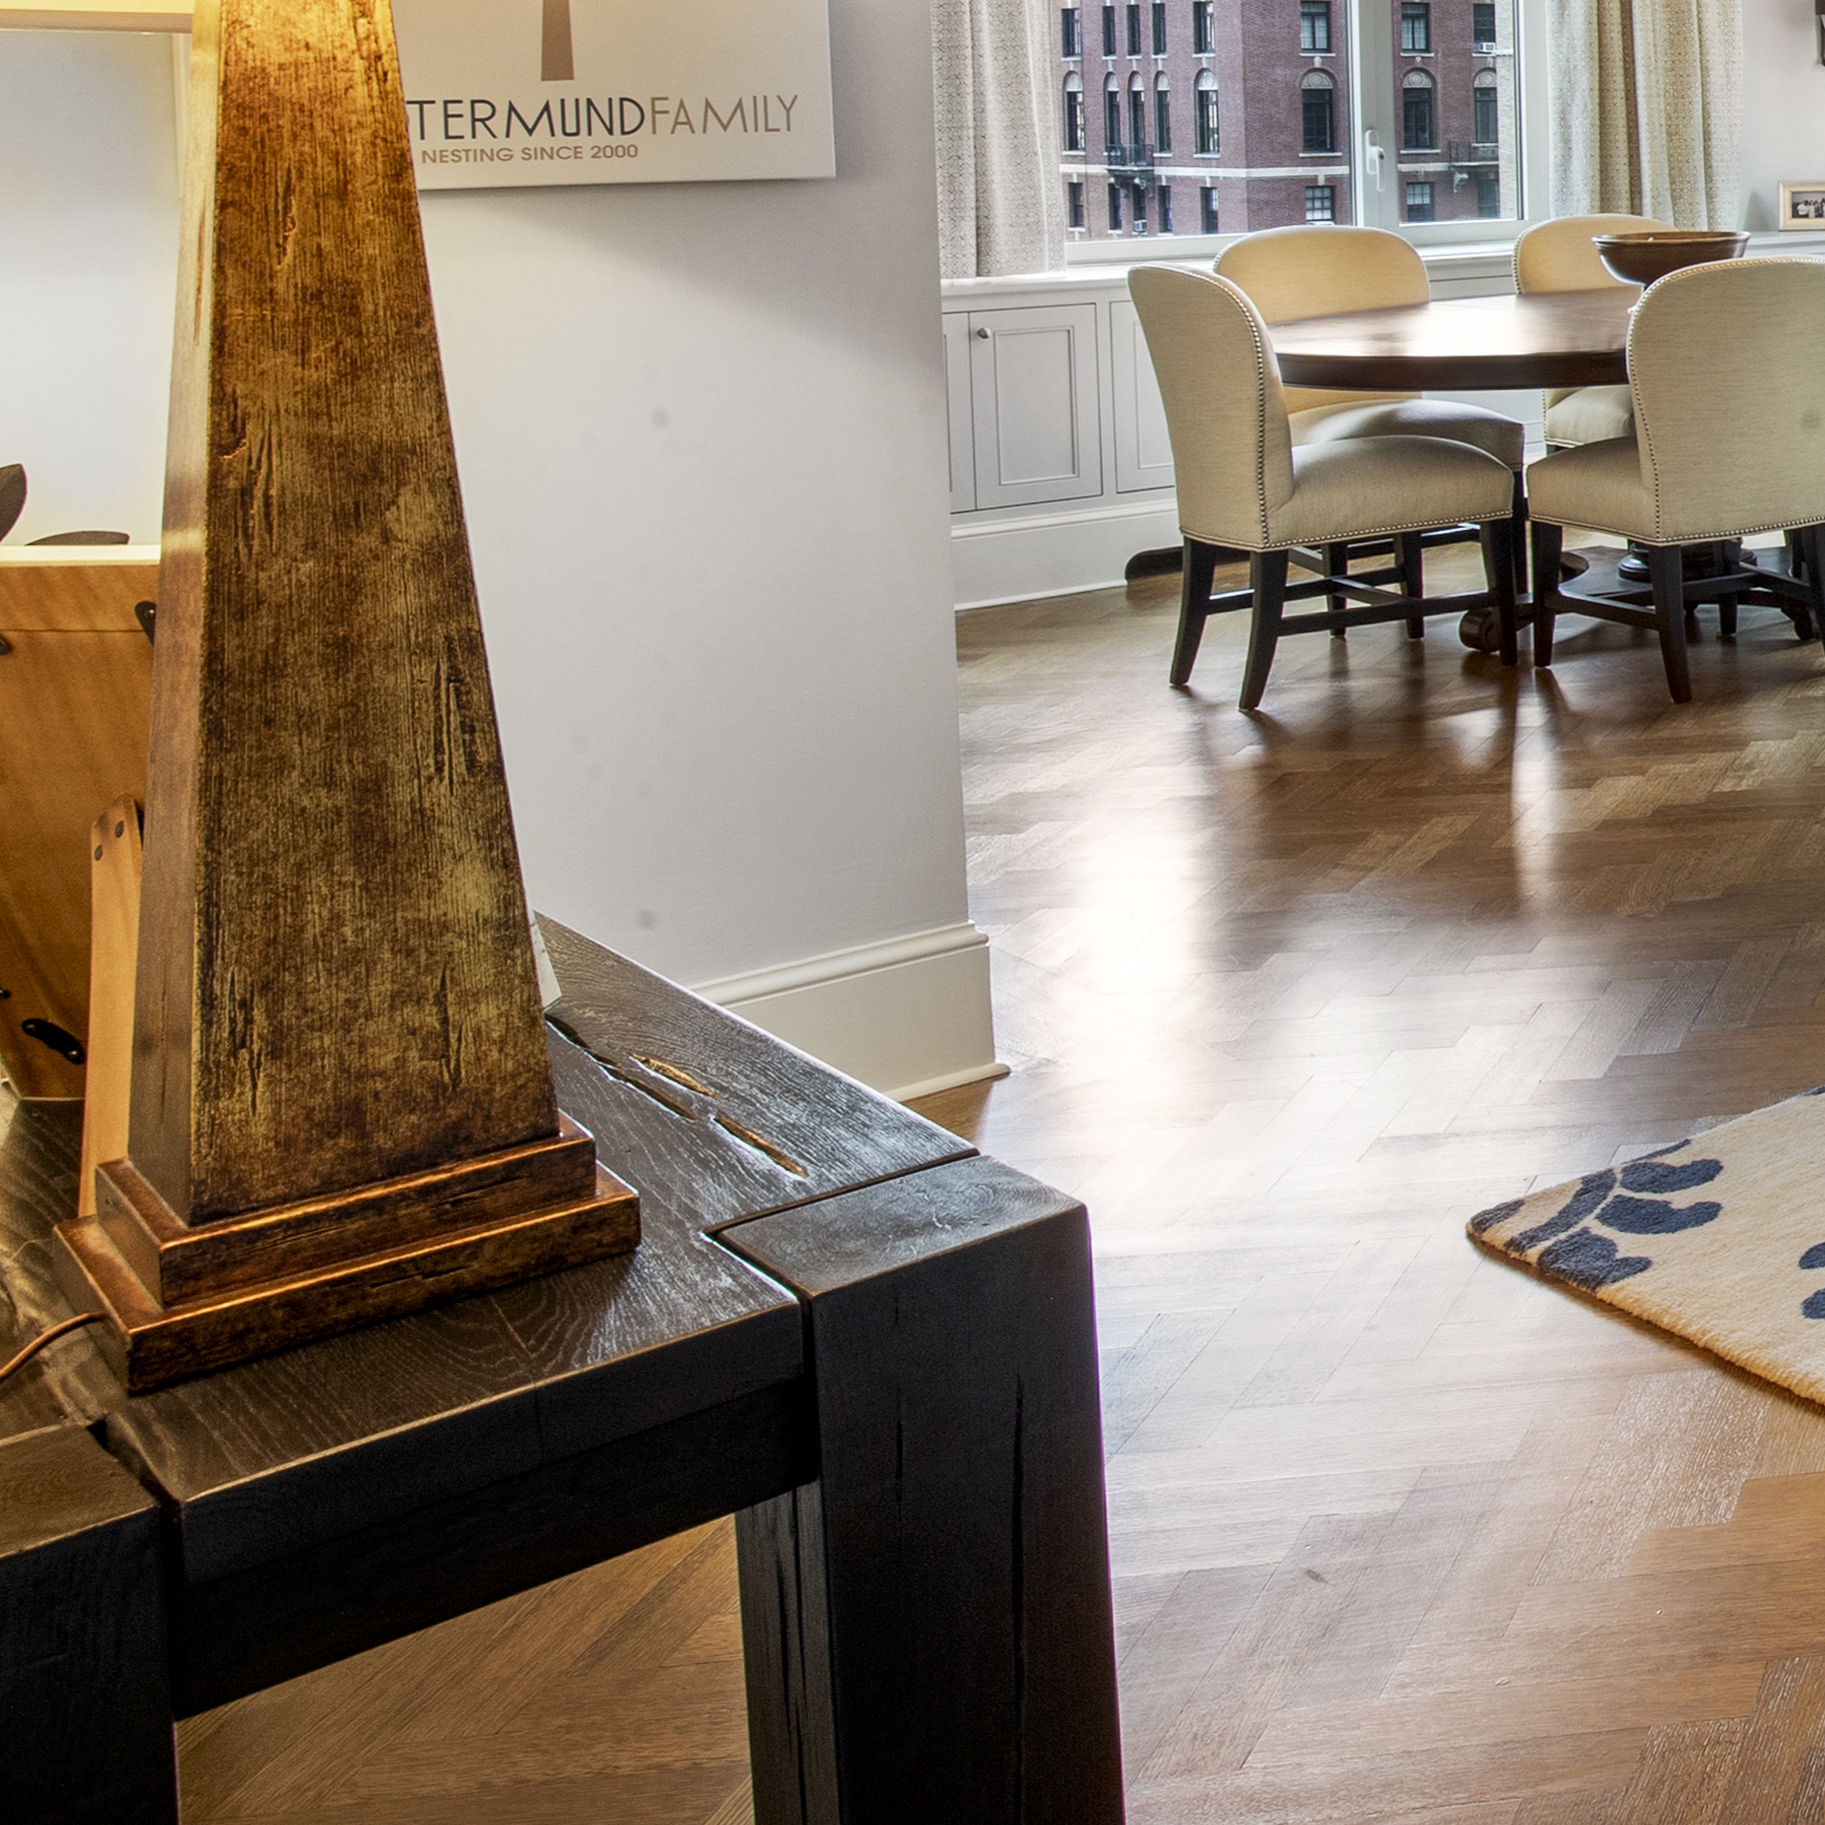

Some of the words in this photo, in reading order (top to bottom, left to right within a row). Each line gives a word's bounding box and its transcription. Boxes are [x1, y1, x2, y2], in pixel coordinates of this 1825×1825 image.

[421, 146, 514, 164] NESTING
[520, 145, 583, 161] SINCE
[590, 143, 639, 159] 2000
